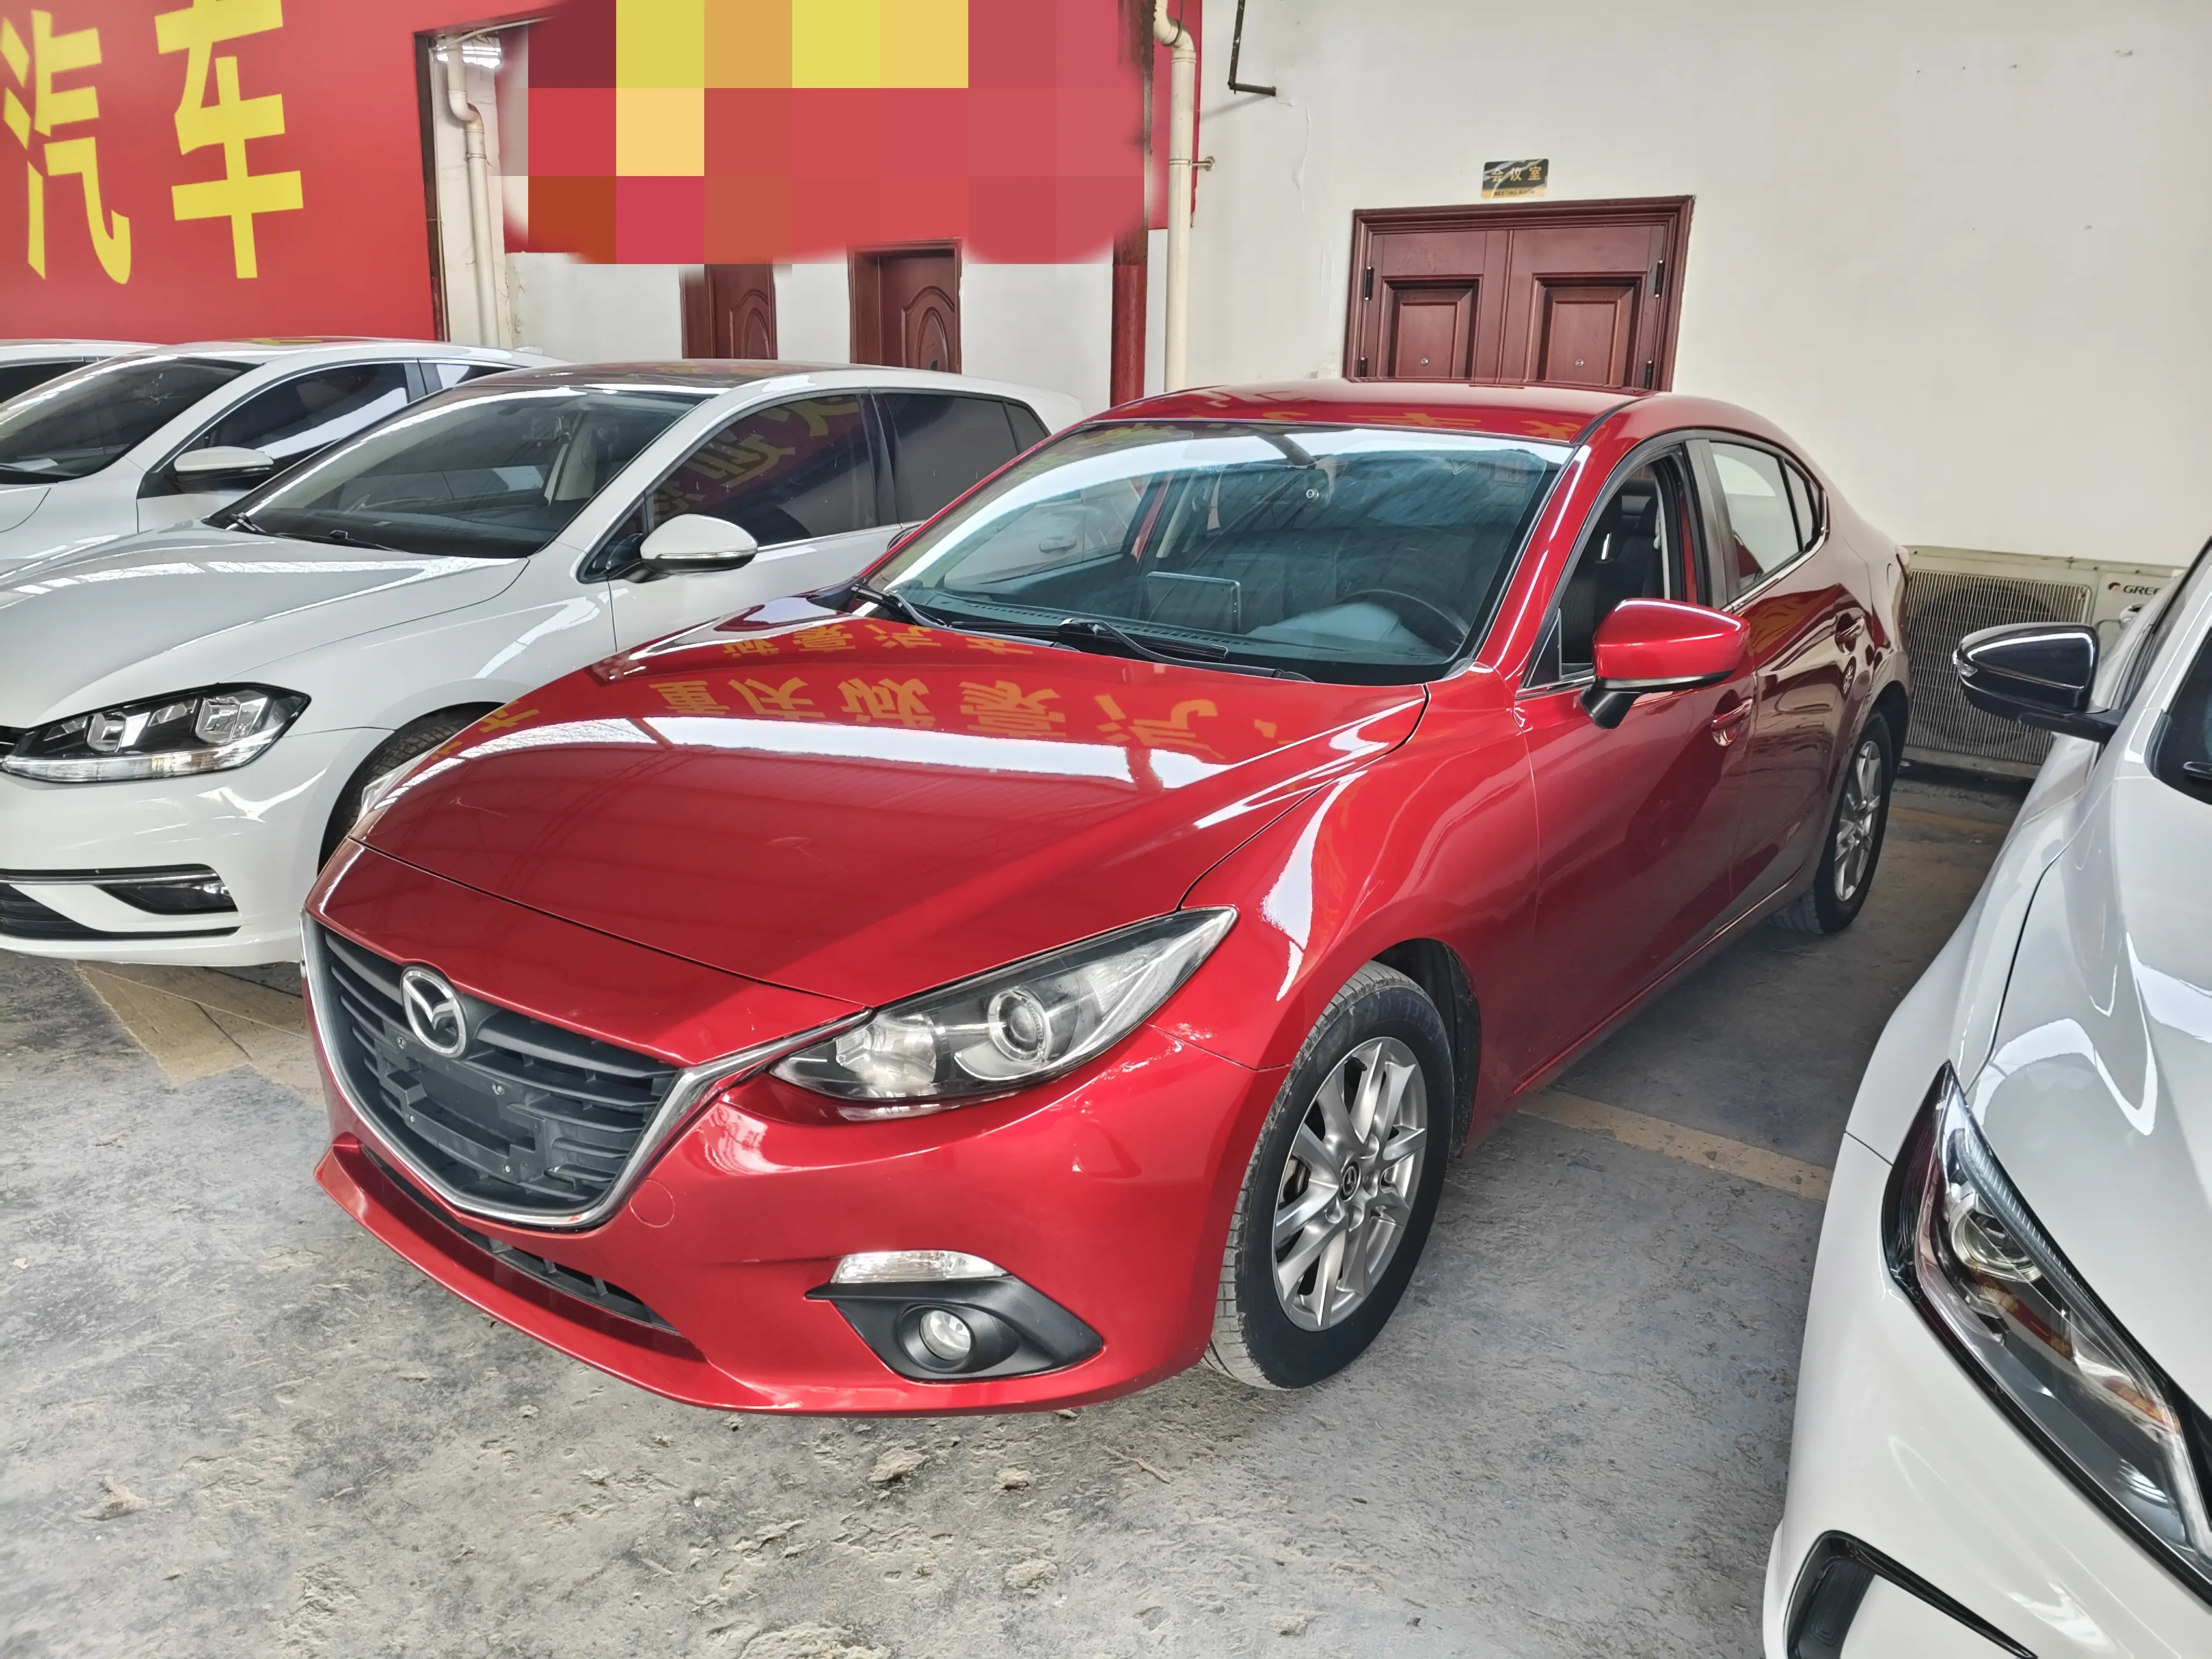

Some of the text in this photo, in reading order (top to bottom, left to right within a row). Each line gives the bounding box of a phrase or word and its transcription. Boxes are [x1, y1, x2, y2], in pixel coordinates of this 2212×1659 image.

[0, 0, 304, 284] 汽车
[1492, 166, 1542, 182] 会议室
